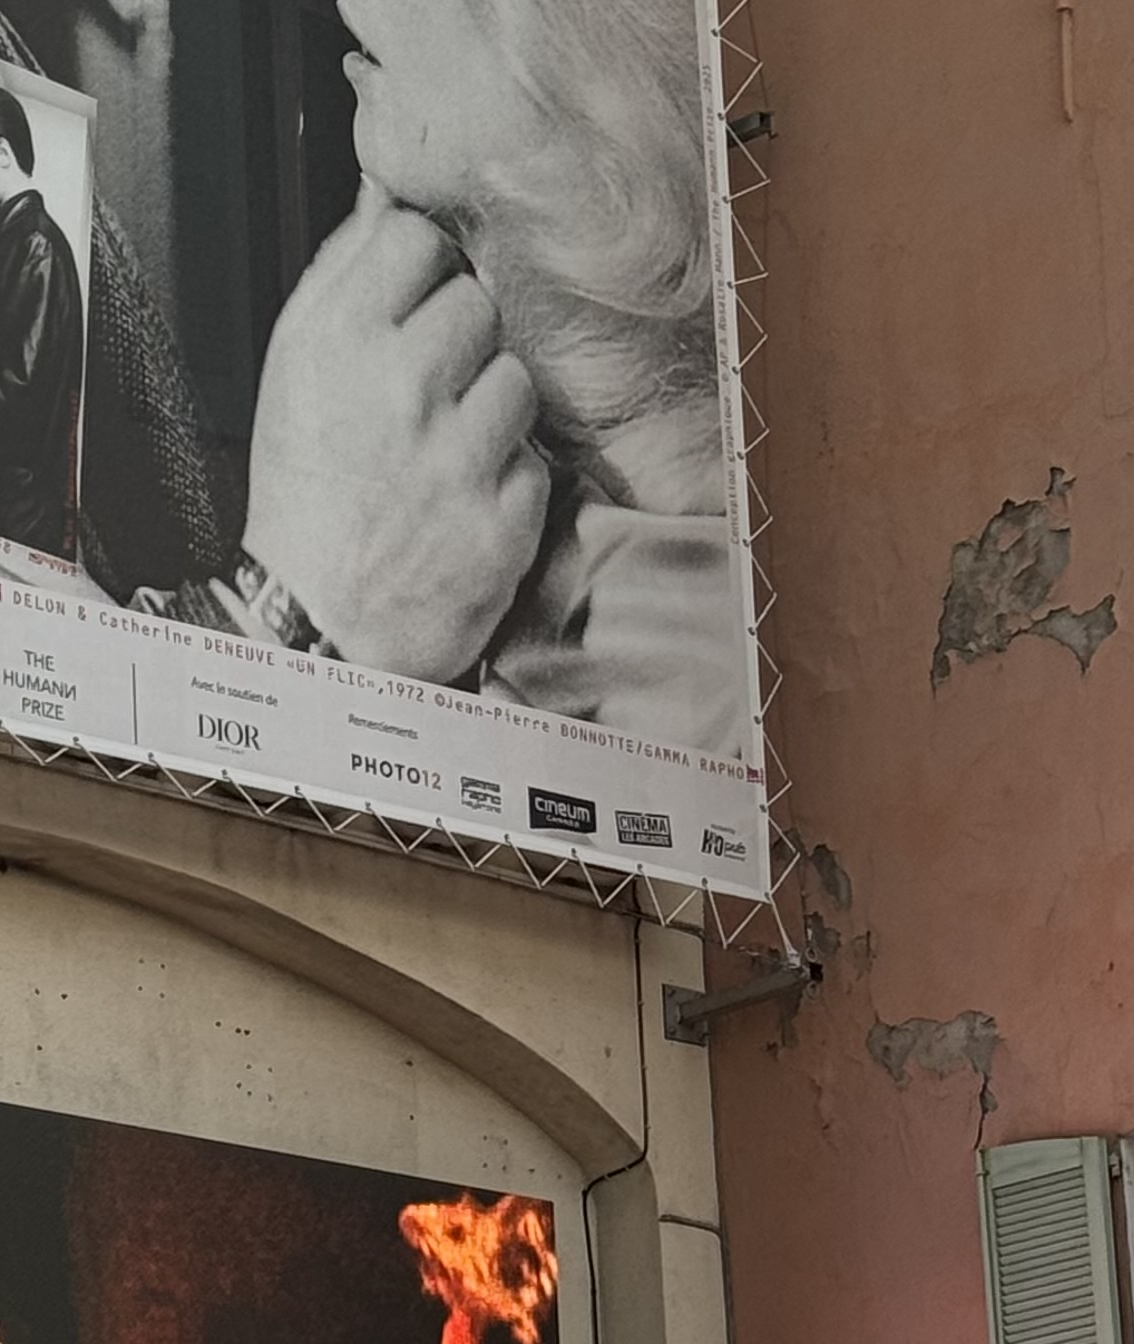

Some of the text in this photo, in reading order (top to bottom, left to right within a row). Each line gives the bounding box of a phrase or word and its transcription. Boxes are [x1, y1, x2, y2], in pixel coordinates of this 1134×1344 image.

[23, 649, 55, 672] THE
[13, 590, 67, 616] DELON
[77, 605, 87, 622] &
[99, 611, 193, 646] Catherine
[204, 635, 275, 666] DENEUVE
[700, 756, 745, 781] RAPHO
[21, 696, 66, 722] PRIZE
[198, 713, 262, 751] DIOR
[350, 753, 442, 791] PHOTO12
[534, 796, 591, 823] cineum
